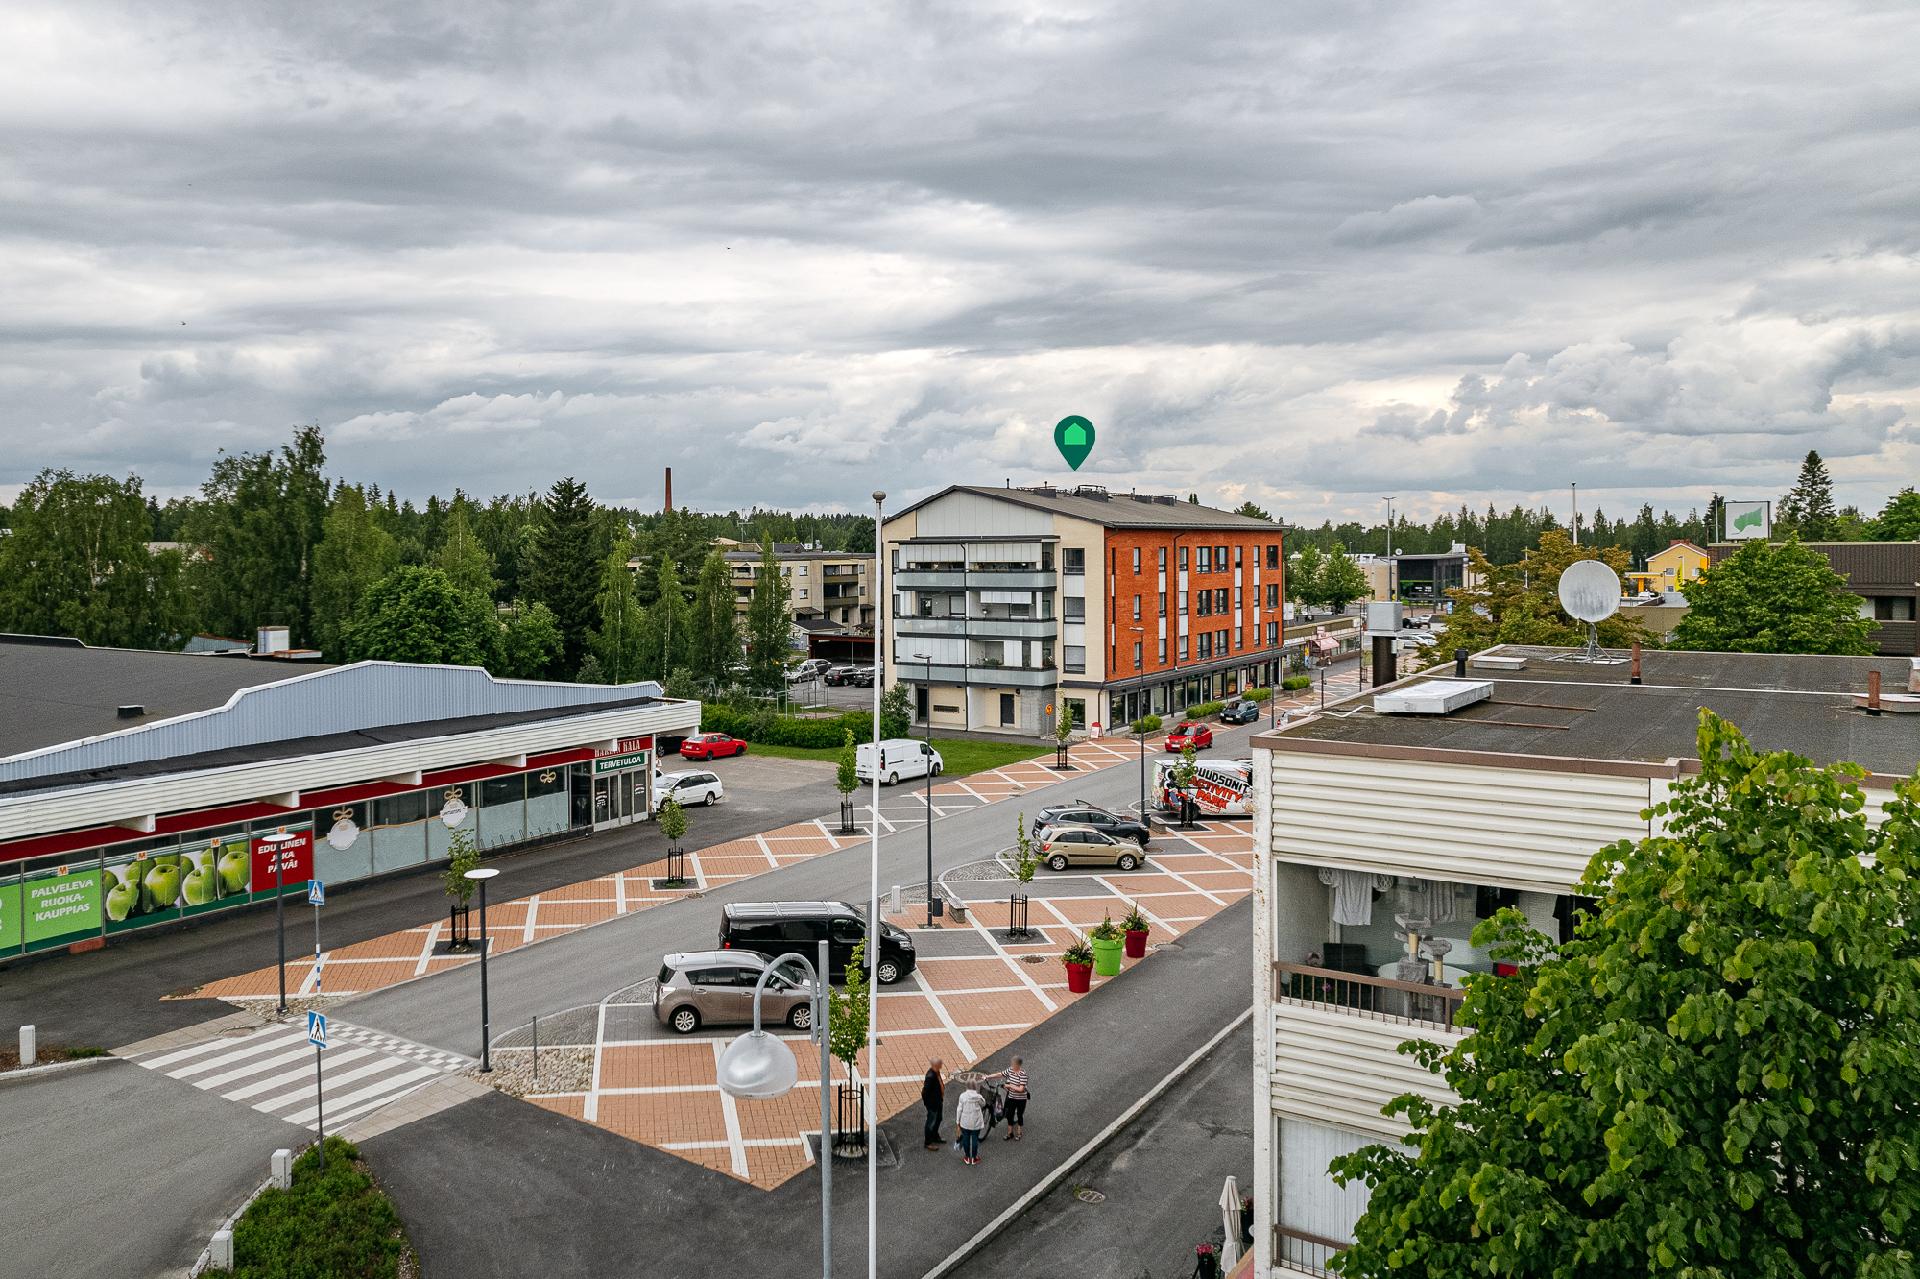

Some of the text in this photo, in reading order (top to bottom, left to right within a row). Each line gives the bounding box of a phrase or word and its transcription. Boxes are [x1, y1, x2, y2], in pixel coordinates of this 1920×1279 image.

[600, 756, 641, 769] TERVETULOA
[1188, 776, 1243, 803] ACTIVITY
[1196, 789, 1230, 809] PARK
[257, 838, 306, 854] EDULINEN
[271, 850, 295, 862] JKA
[31, 880, 93, 898] PALVELEVA
[41, 893, 84, 908] RUOKA-
[35, 903, 90, 922] KAUPPIAS
